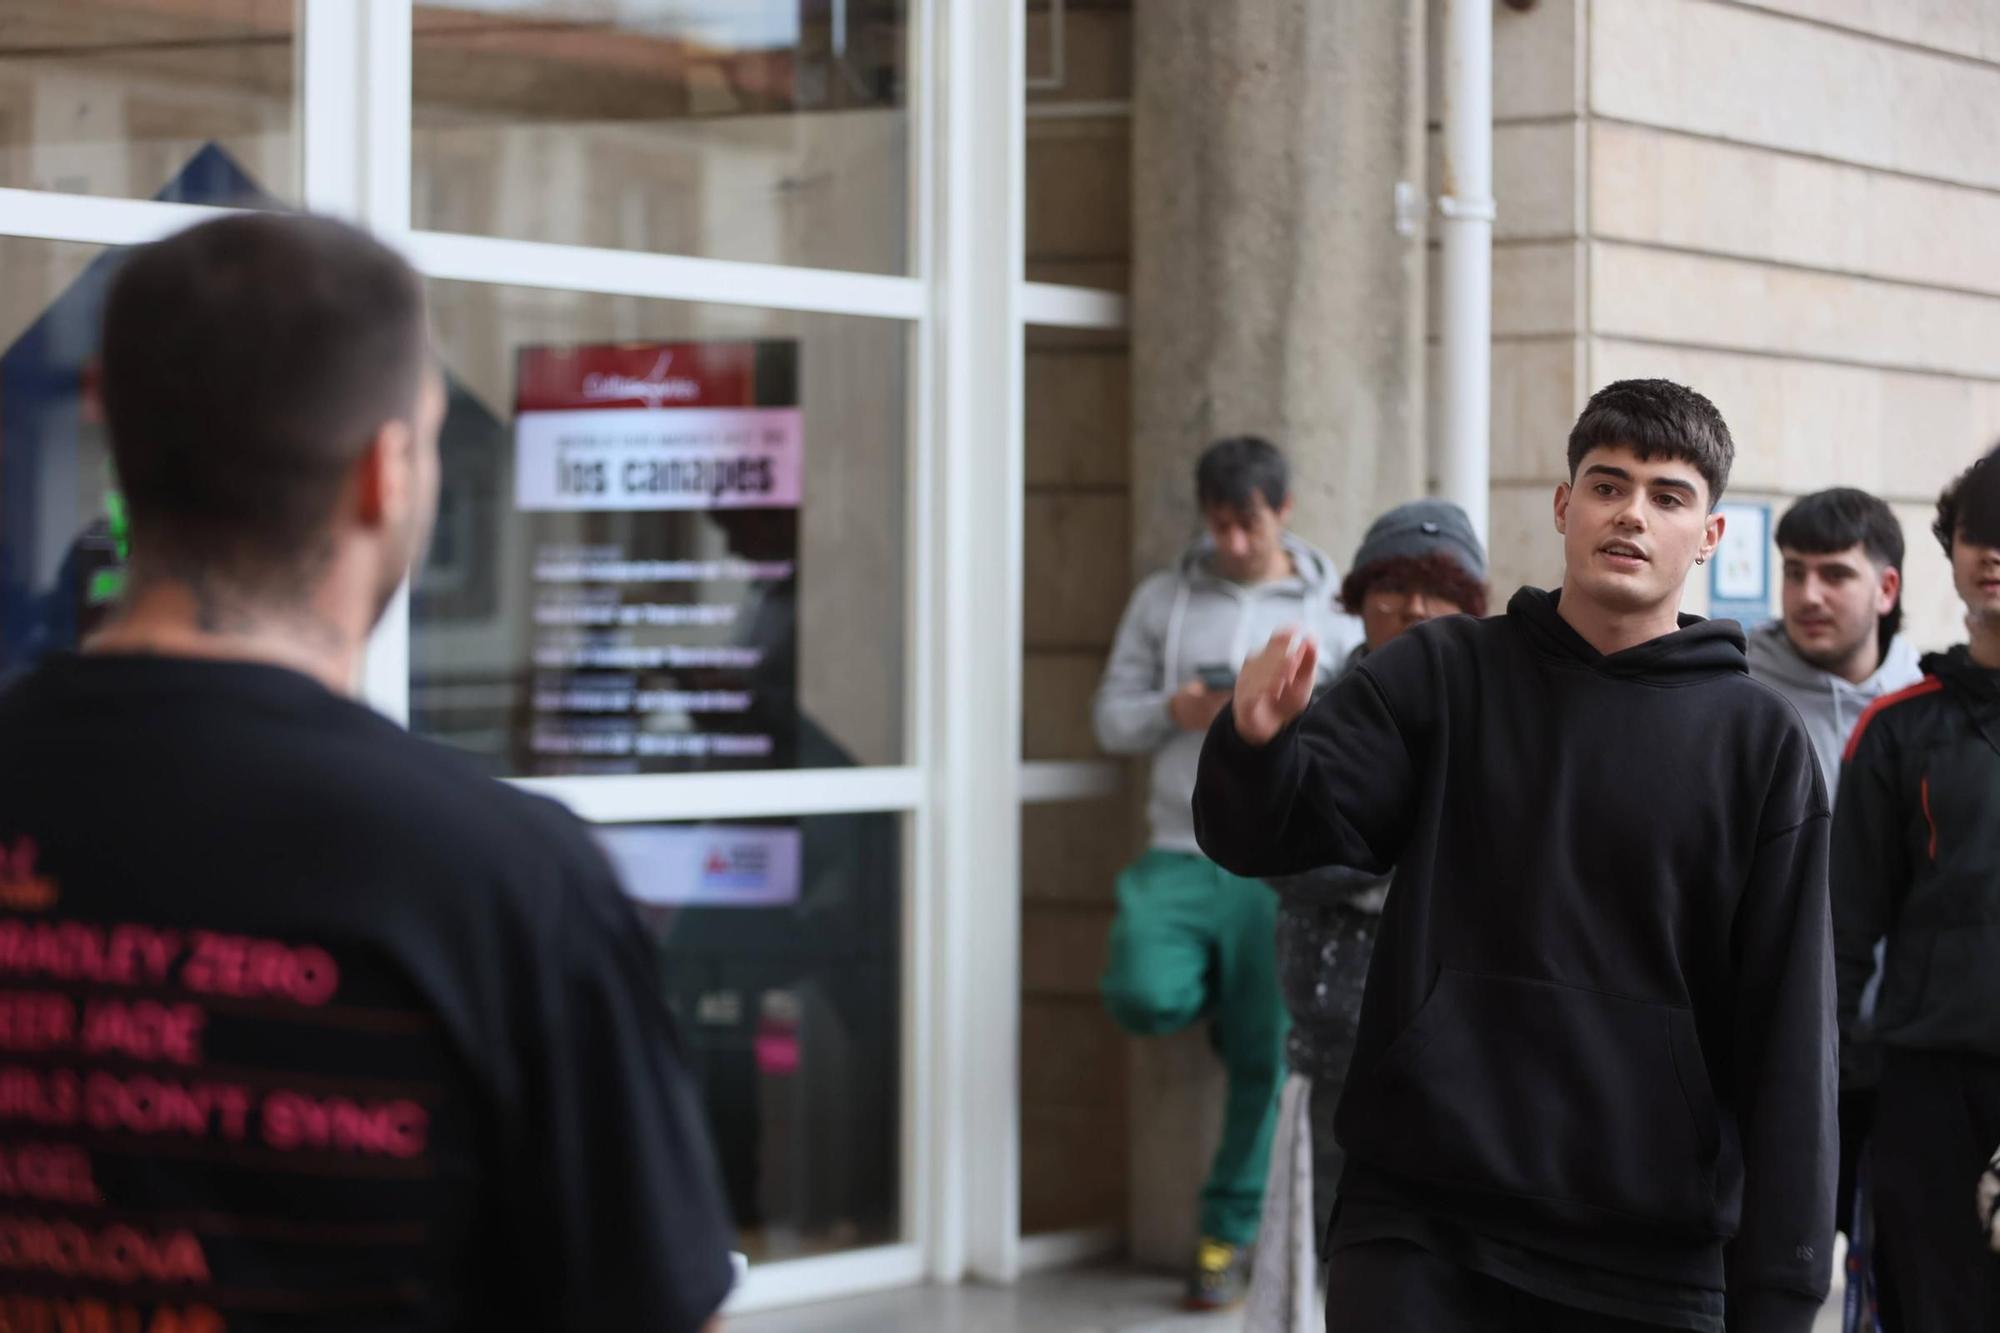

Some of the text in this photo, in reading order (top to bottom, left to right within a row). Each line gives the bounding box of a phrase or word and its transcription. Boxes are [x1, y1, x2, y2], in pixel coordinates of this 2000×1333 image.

[556, 452, 606, 495] los
[182, 928, 341, 1006] ZERO
[84, 997, 207, 1064] JADE
[261, 1088, 430, 1159] SYNC
